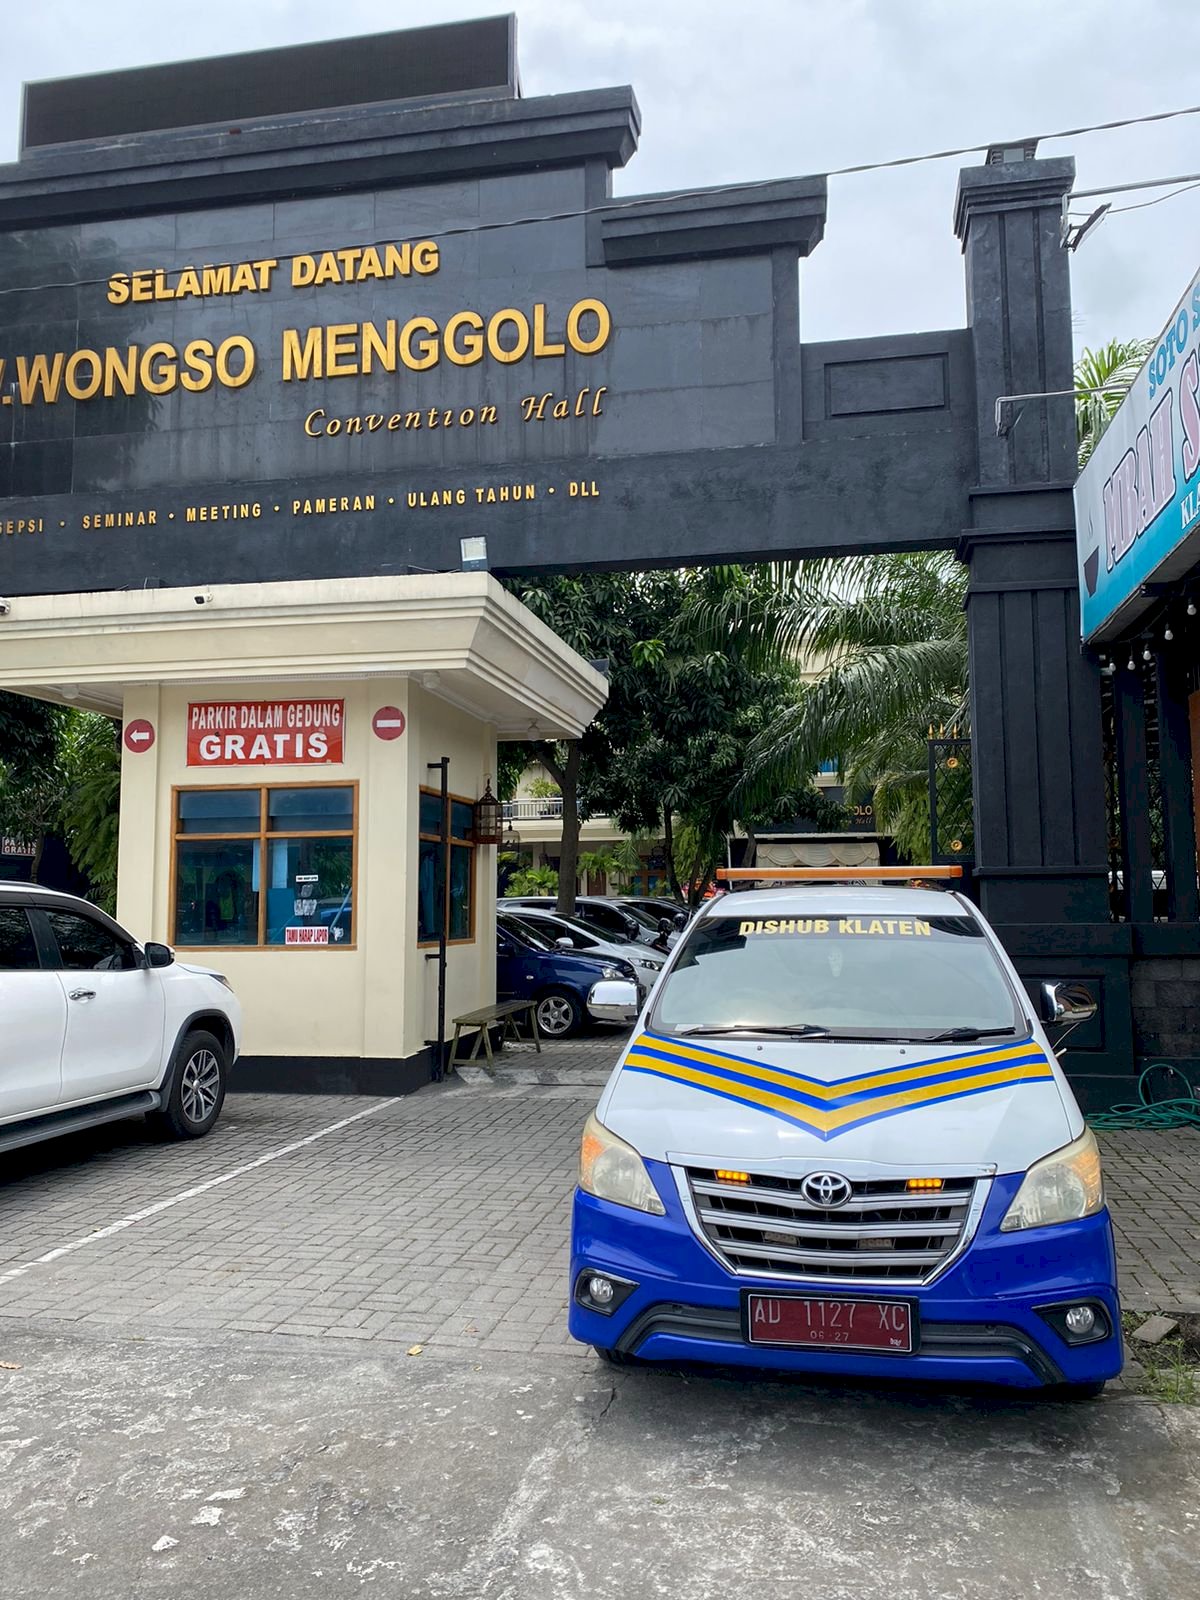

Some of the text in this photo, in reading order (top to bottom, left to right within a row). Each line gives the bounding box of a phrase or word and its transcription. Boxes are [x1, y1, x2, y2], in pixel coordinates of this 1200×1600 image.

[107, 240, 440, 305] SELAMAT DATANG
[0, 297, 612, 406] .WONGSO MENGGOLO
[1148, 308, 1189, 401] SOTO
[303, 386, 607, 437] Convention Hall
[82, 510, 157, 529] SEMINAR
[186, 503, 262, 522] MEETING
[292, 494, 376, 515] PAMERAN
[407, 488, 466, 507] ULANG
[475, 484, 536, 503] TAHUN
[569, 480, 600, 497] DLL
[1103, 387, 1176, 573] MBAH
[192, 703, 340, 730] PARKIR DALAM GEDUNG
[199, 732, 328, 760] GRATIS
[738, 919, 932, 937] DISHUB KLATEN
[754, 1299, 905, 1331] AD 1127 XC
